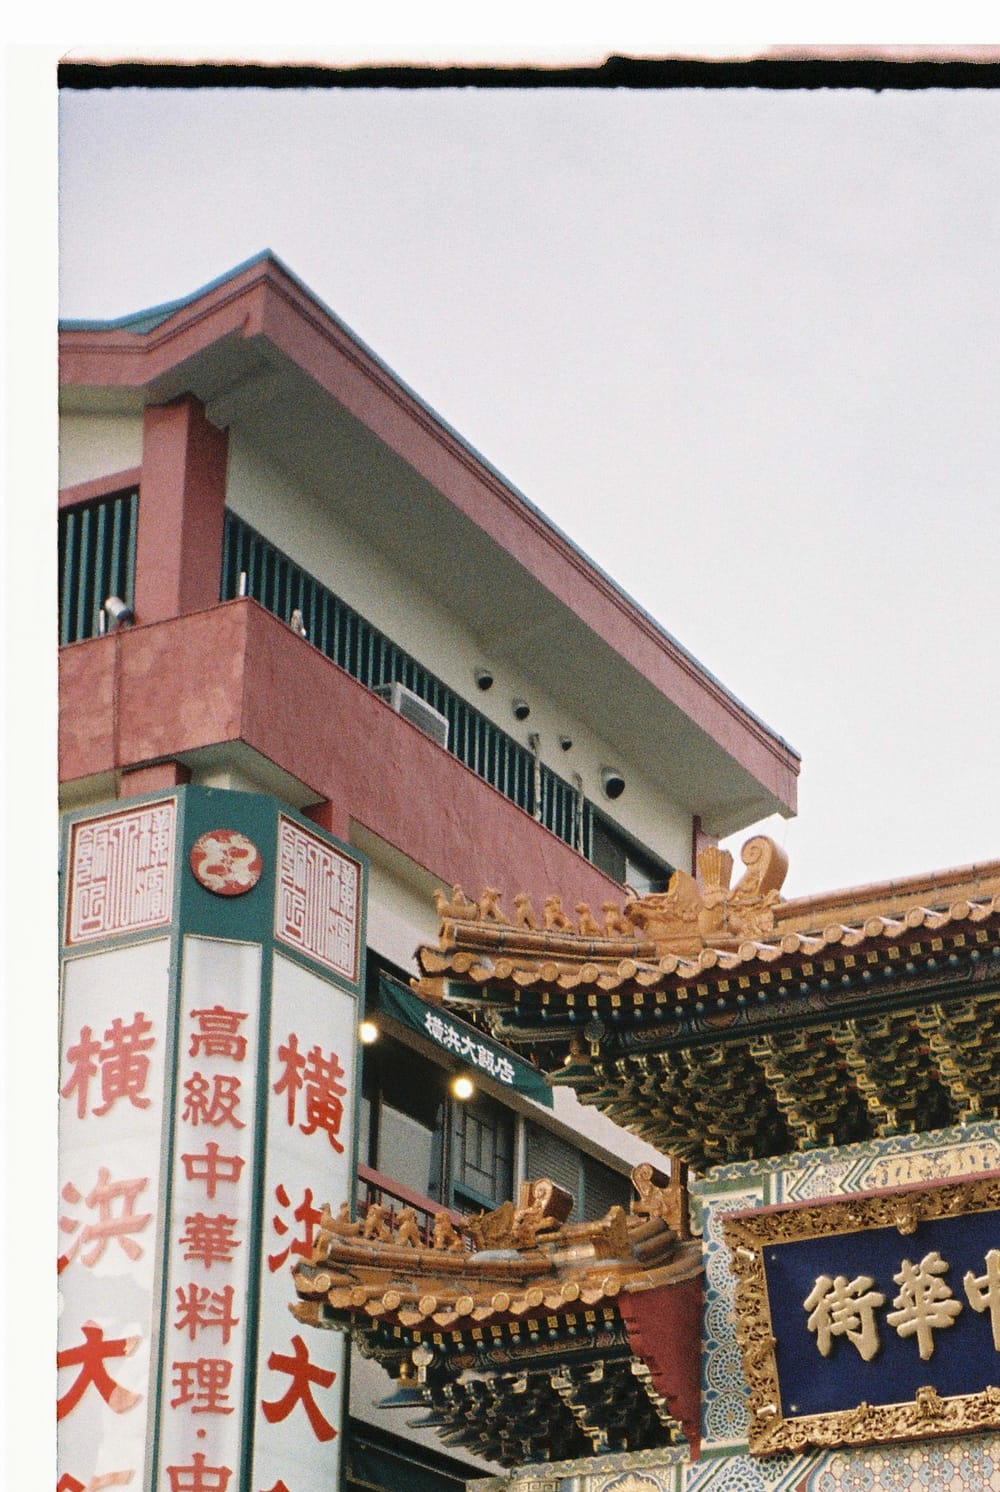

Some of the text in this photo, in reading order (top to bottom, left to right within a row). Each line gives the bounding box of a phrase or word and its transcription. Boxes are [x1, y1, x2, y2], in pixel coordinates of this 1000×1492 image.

[424, 1011, 515, 1084] 横浜大飯店
